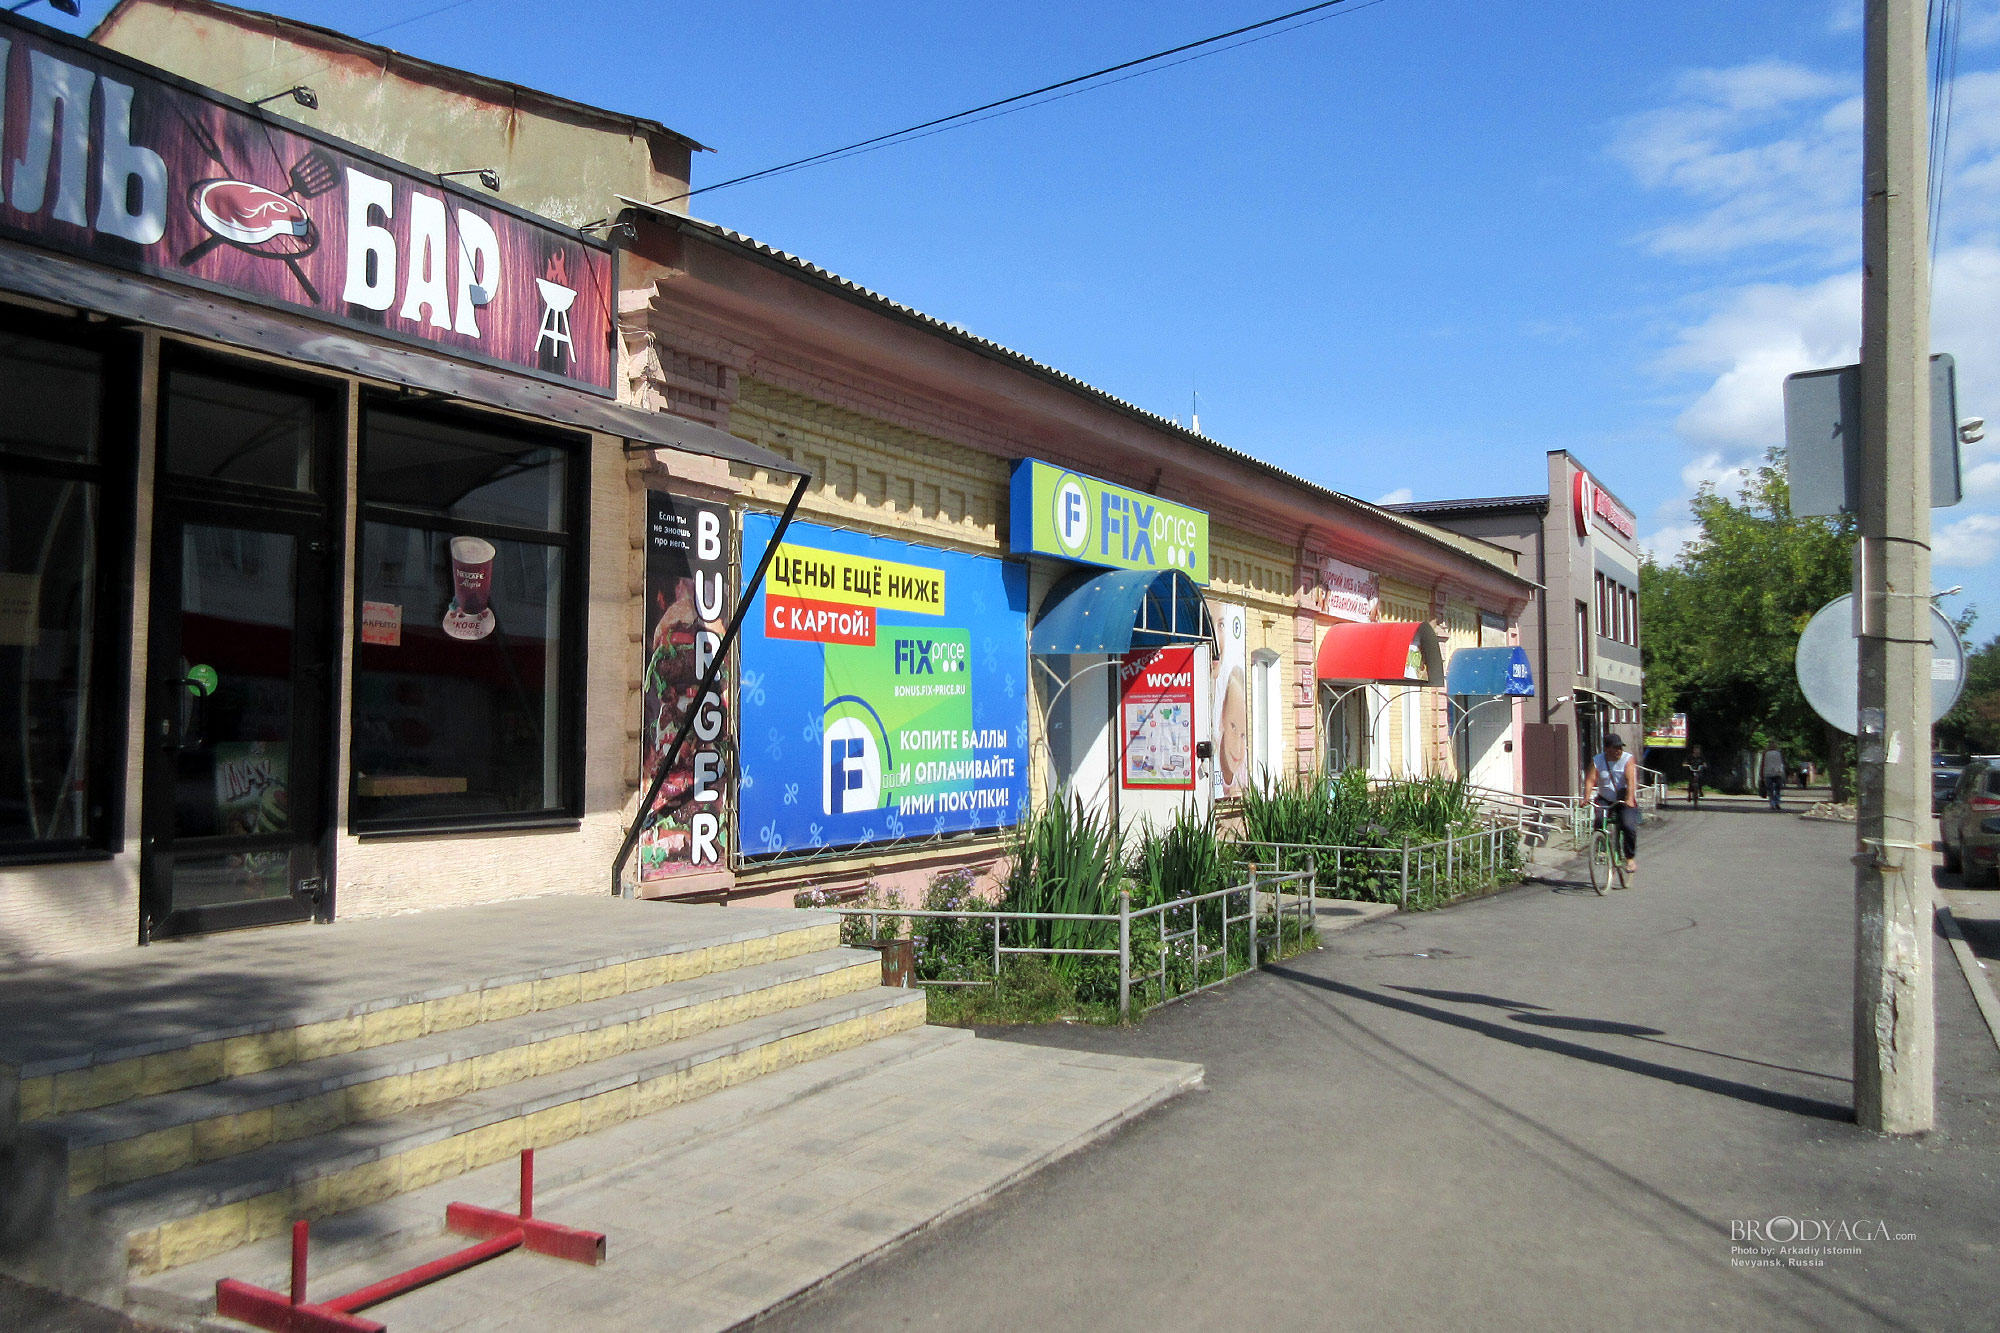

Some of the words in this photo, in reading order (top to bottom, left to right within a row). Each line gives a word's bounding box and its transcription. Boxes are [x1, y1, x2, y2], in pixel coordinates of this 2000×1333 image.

[343, 166, 501, 339] БАР
[653, 524, 663, 533] не
[659, 511, 675, 522] Если
[676, 515, 687, 525] ты
[654, 537, 668, 547] про
[775, 556, 836, 590] ЦЕНЫ
[843, 565, 882, 598] ЕЩЁ
[888, 574, 939, 604] НИЖЕ
[772, 606, 785, 629] С
[791, 607, 870, 637] КАРТОЙ!
[691, 511, 723, 866] BURGER
[894, 684, 966, 697] BONUS.FIX-PRICE.RU
[1146, 672, 1191, 688] WOW!
[900, 730, 958, 750] КОПИТЕ
[962, 729, 1008, 750] БАЛЛЫ
[900, 762, 911, 783] И
[915, 755, 1015, 784] ОПЛАЧИВАЙТЕ
[900, 794, 934, 816] ИМИ
[938, 788, 1009, 813] ПОКУПКИ!
